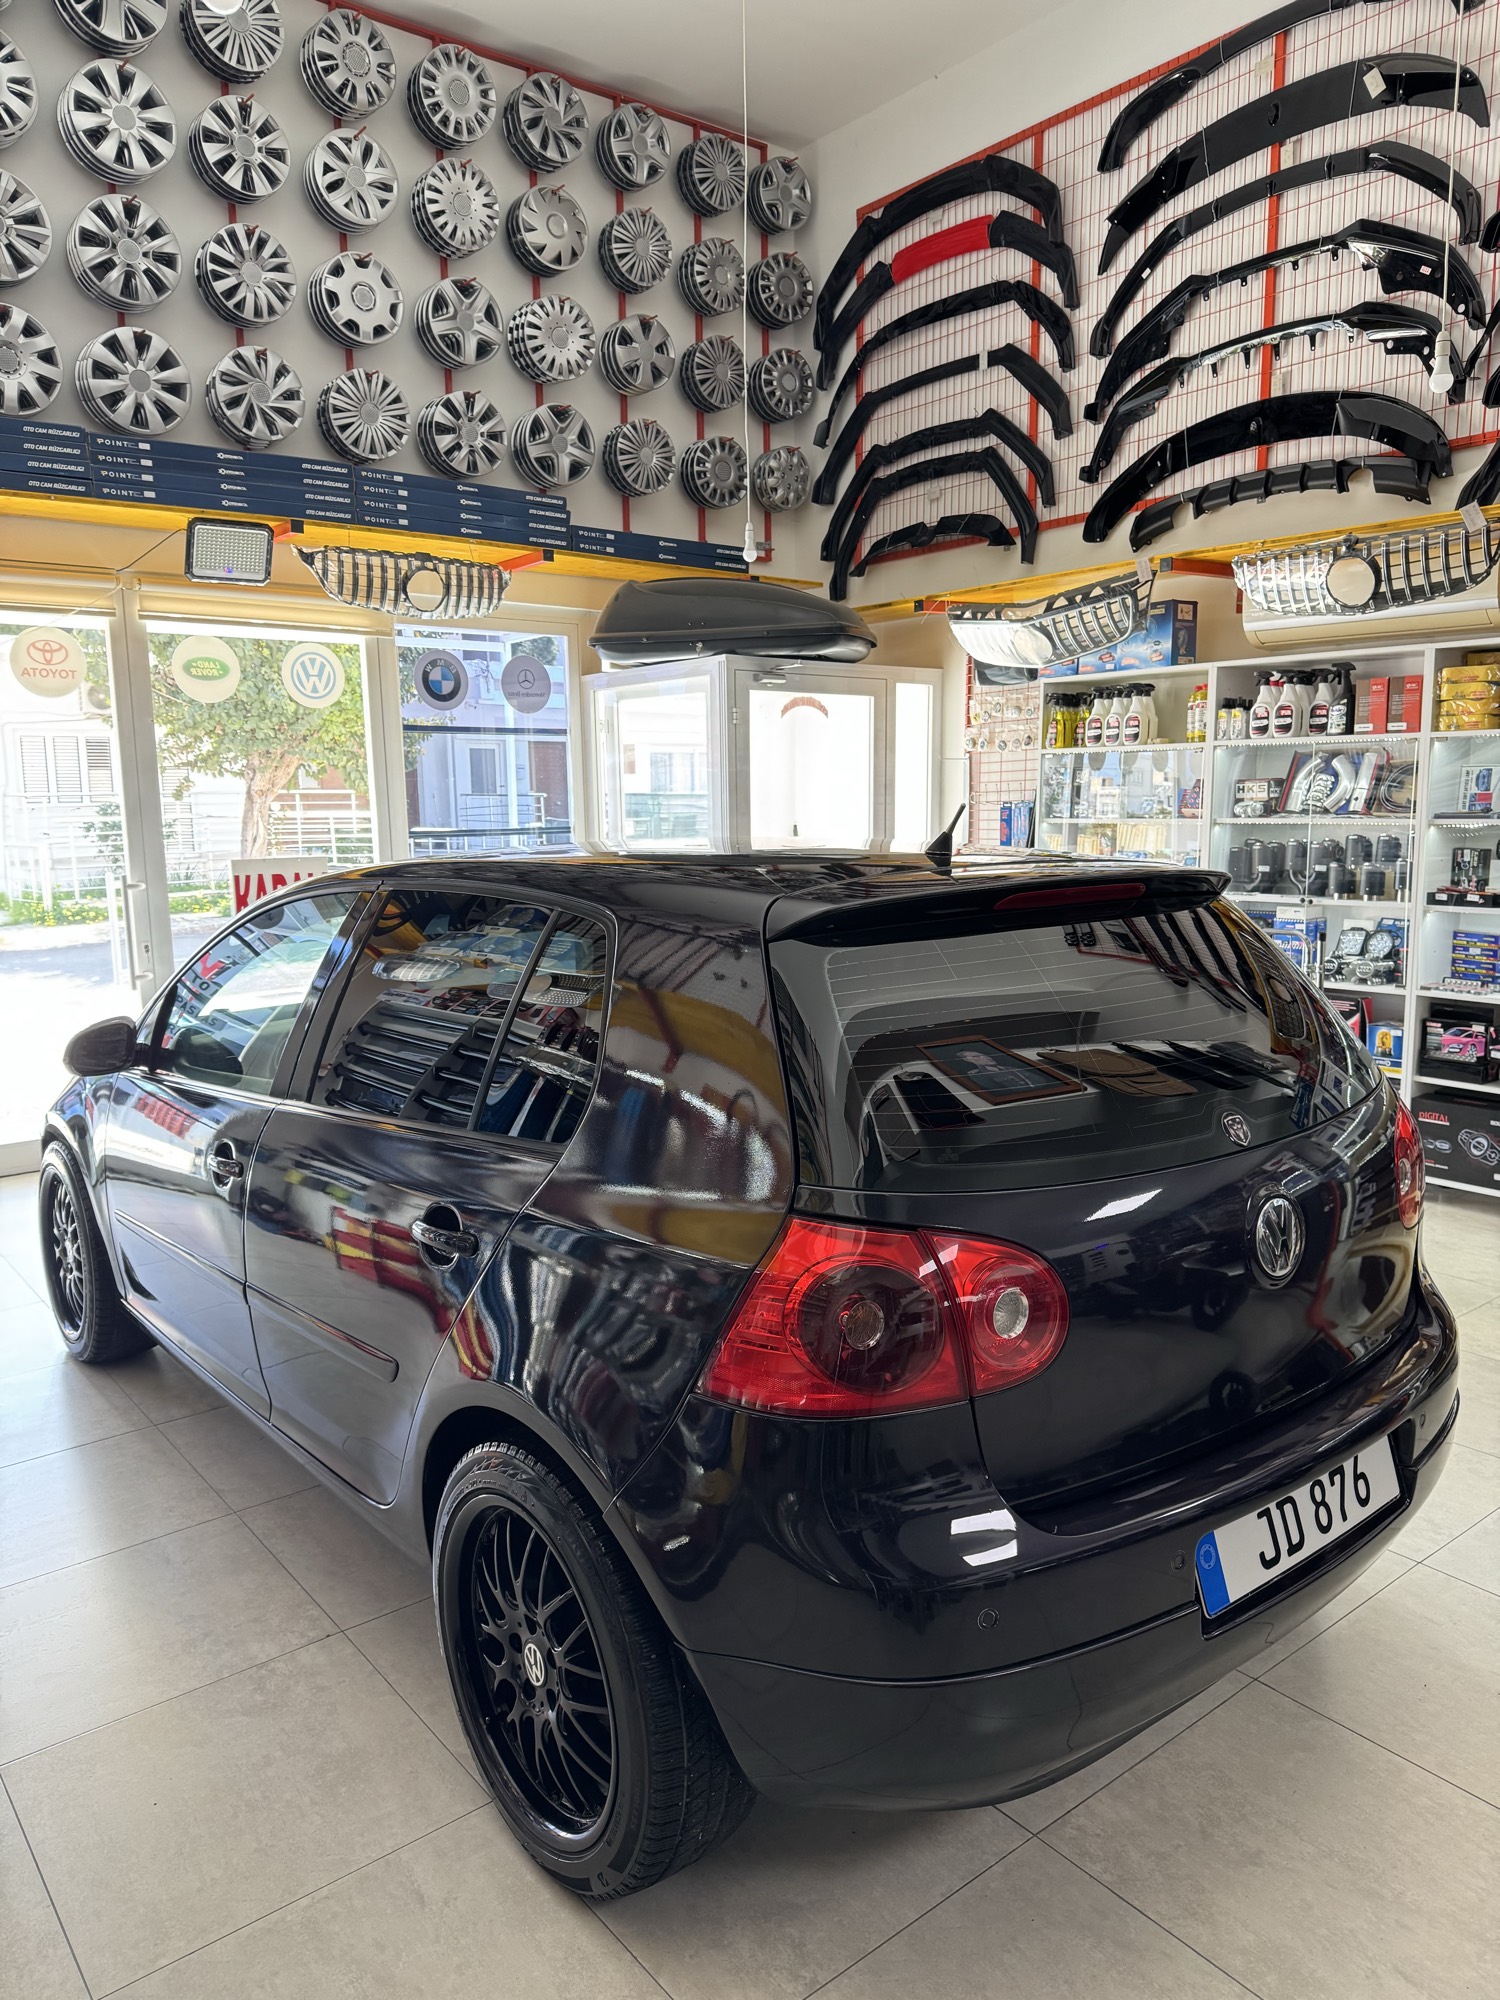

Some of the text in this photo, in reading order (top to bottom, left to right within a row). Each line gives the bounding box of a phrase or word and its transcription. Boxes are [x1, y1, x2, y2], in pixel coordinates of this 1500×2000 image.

[96, 438, 128, 447] POINT
[97, 455, 129, 463] POINT
[101, 470, 132, 479] POINT
[361, 471, 387, 479] POINT
[102, 487, 133, 496] POINT
[363, 485, 389, 494] POINT
[363, 500, 389, 508] POINT
[364, 515, 390, 524] POINT
[578, 530, 600, 538] POINT
[1236, 784, 1267, 794] HKS
[1418, 1112, 1448, 1122] DIGITAL
[1257, 1455, 1371, 1570] JD 876
